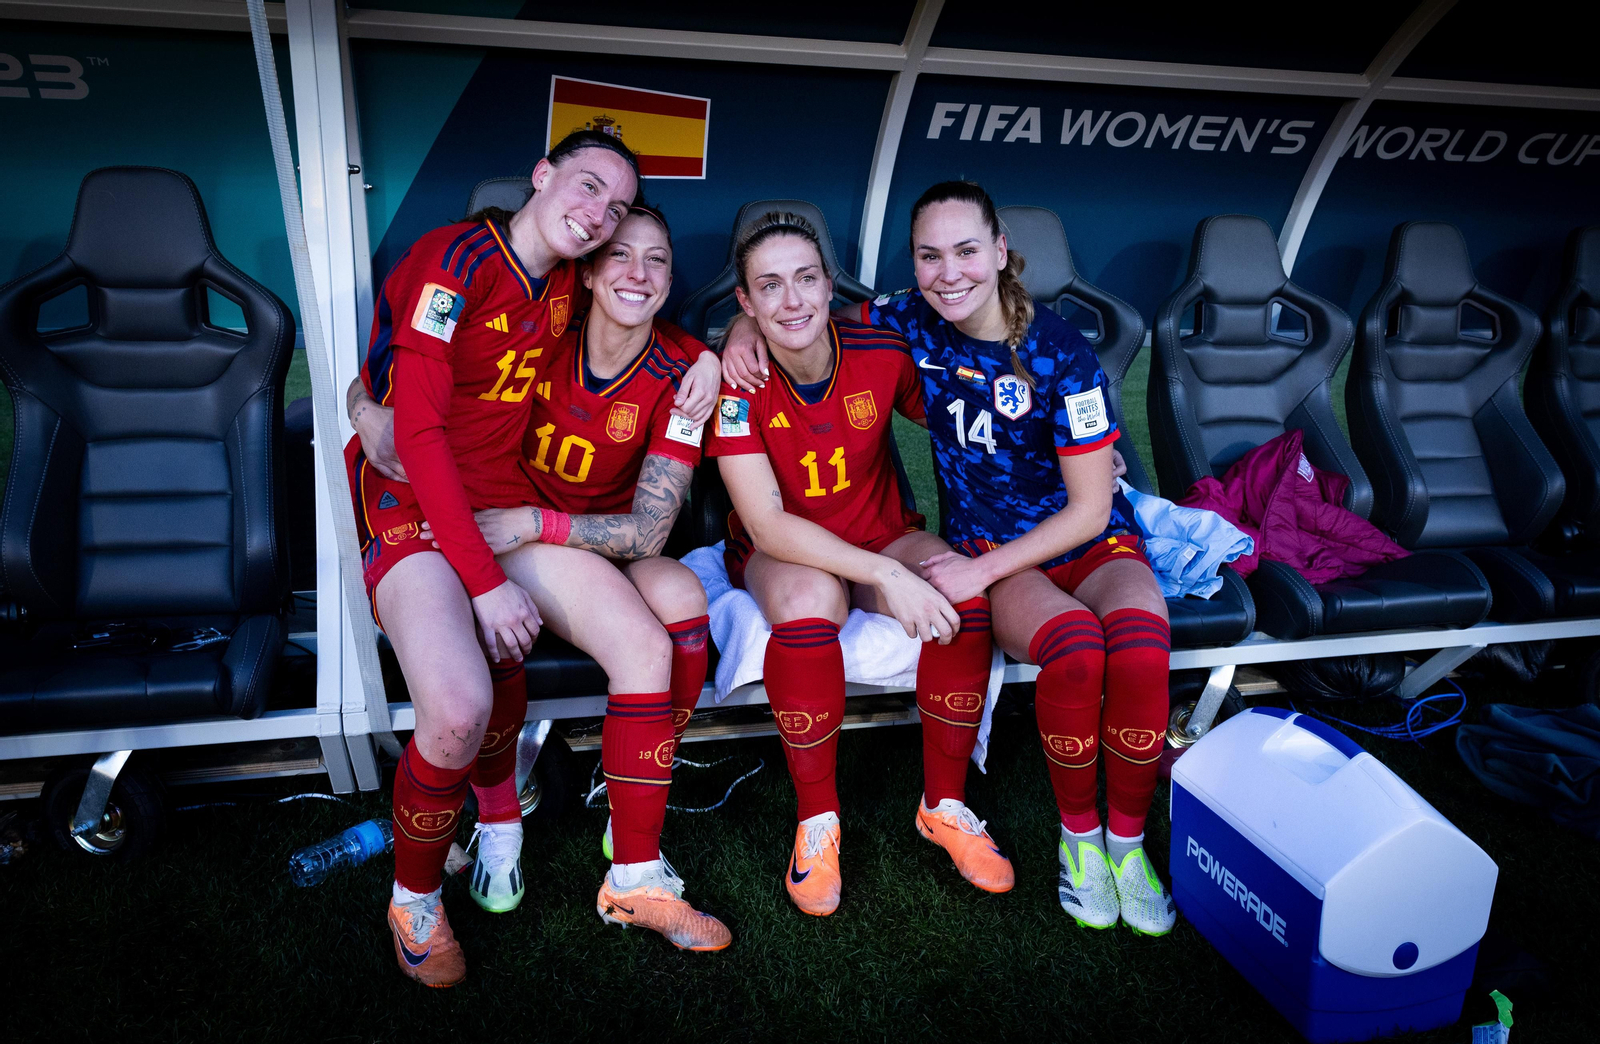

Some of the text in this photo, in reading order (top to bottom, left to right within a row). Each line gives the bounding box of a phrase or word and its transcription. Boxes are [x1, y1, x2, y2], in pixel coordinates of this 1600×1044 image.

[926, 102, 1042, 144] FIFA
[1060, 108, 1315, 155] WOMEN'S
[478, 347, 544, 403] 15
[946, 398, 998, 455] 14
[1076, 402, 1099, 416] UNITES
[529, 422, 596, 483] 10
[799, 446, 851, 497] 11
[638, 750, 652, 760] 19
